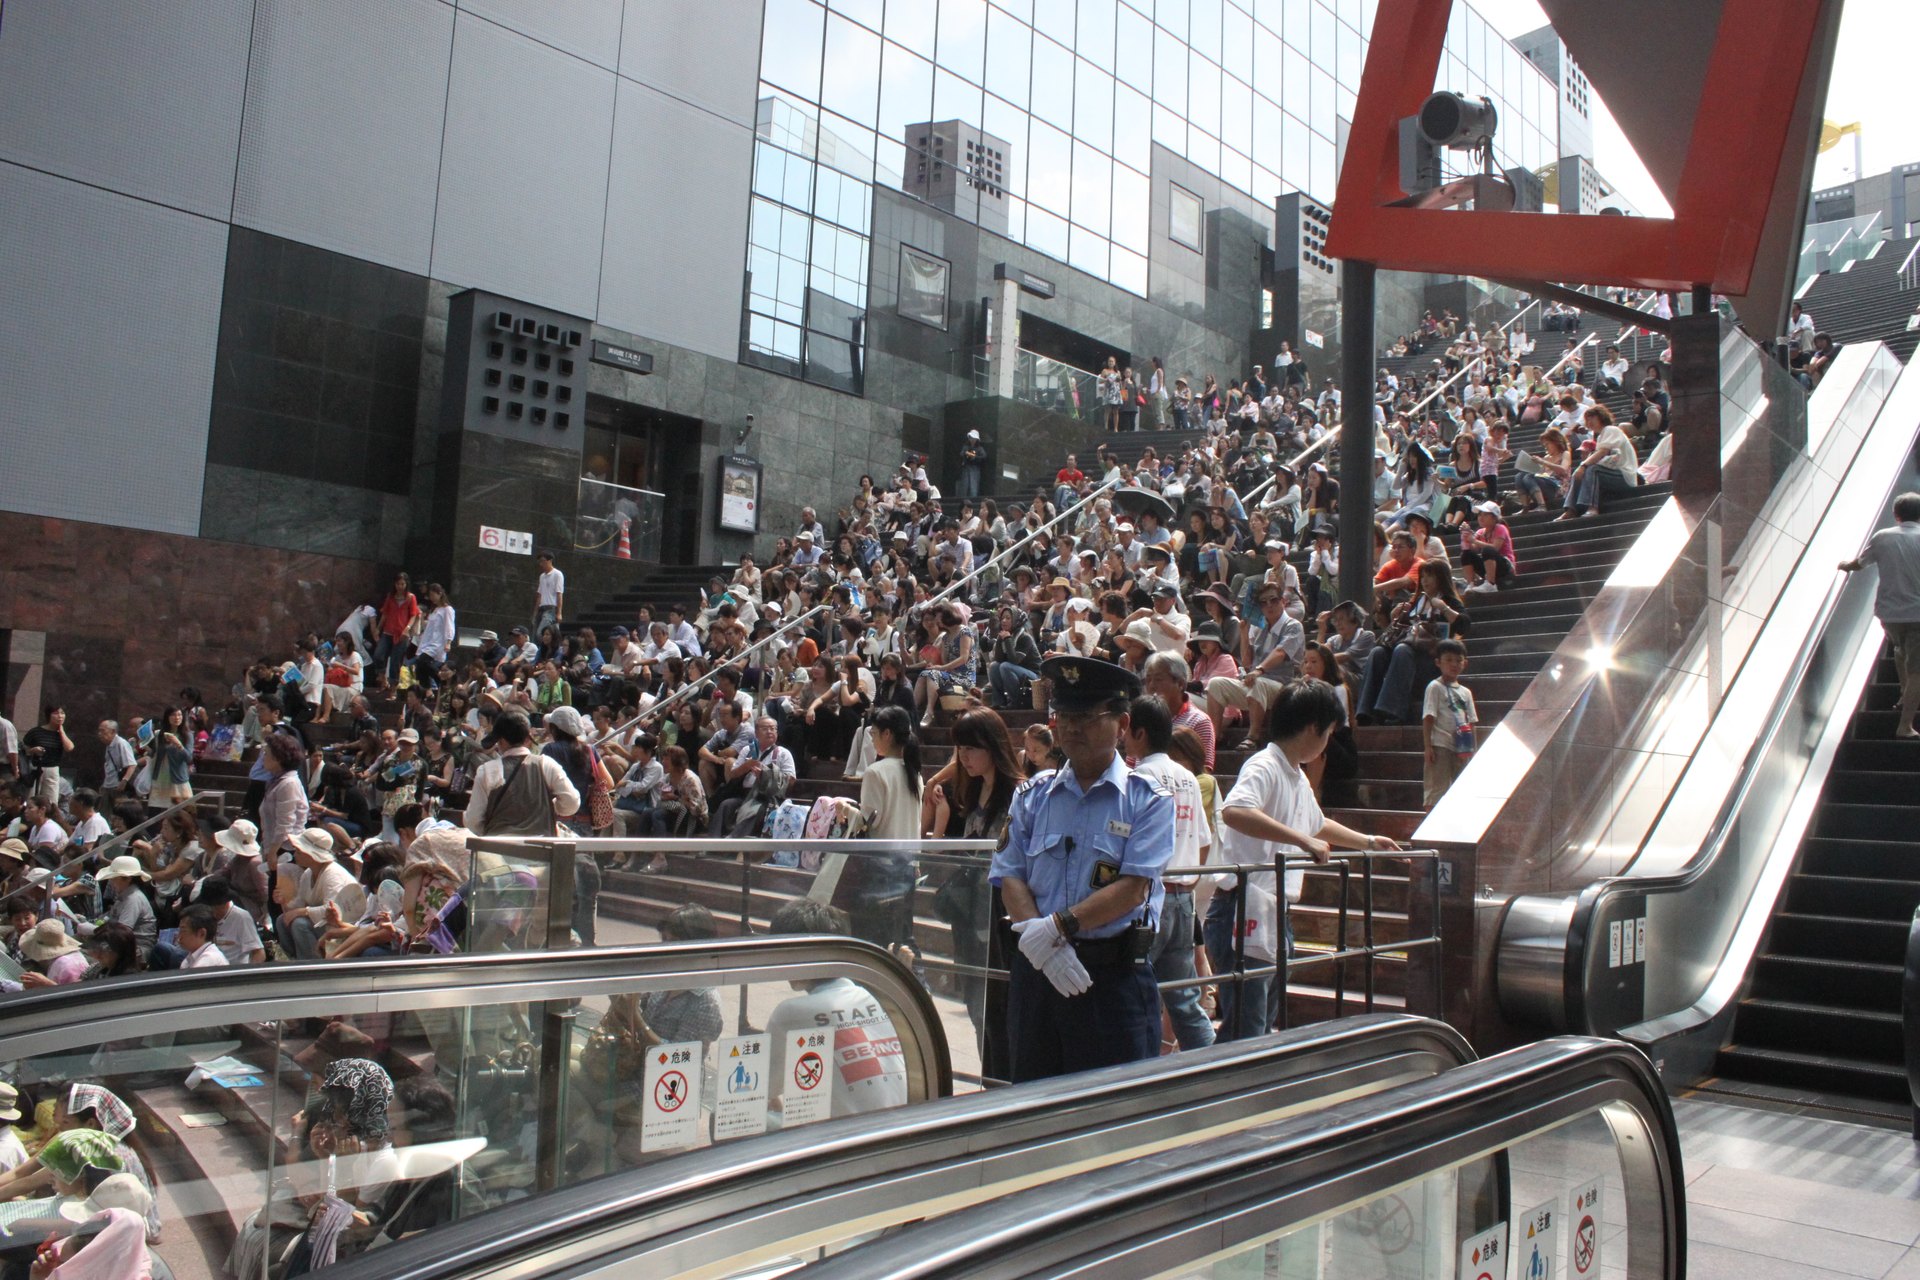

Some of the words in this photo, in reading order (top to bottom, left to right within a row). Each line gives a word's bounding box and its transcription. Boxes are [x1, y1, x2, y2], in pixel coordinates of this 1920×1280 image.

[483, 529, 499, 546] 6
[814, 1004, 887, 1027] STAF
[742, 1042, 761, 1056] 注意
[808, 1034, 826, 1047] 危険
[671, 1050, 692, 1065] 危険
[1586, 1187, 1598, 1208] 危険
[1536, 1211, 1551, 1233] 注意
[1482, 1238, 1499, 1262] 危険
